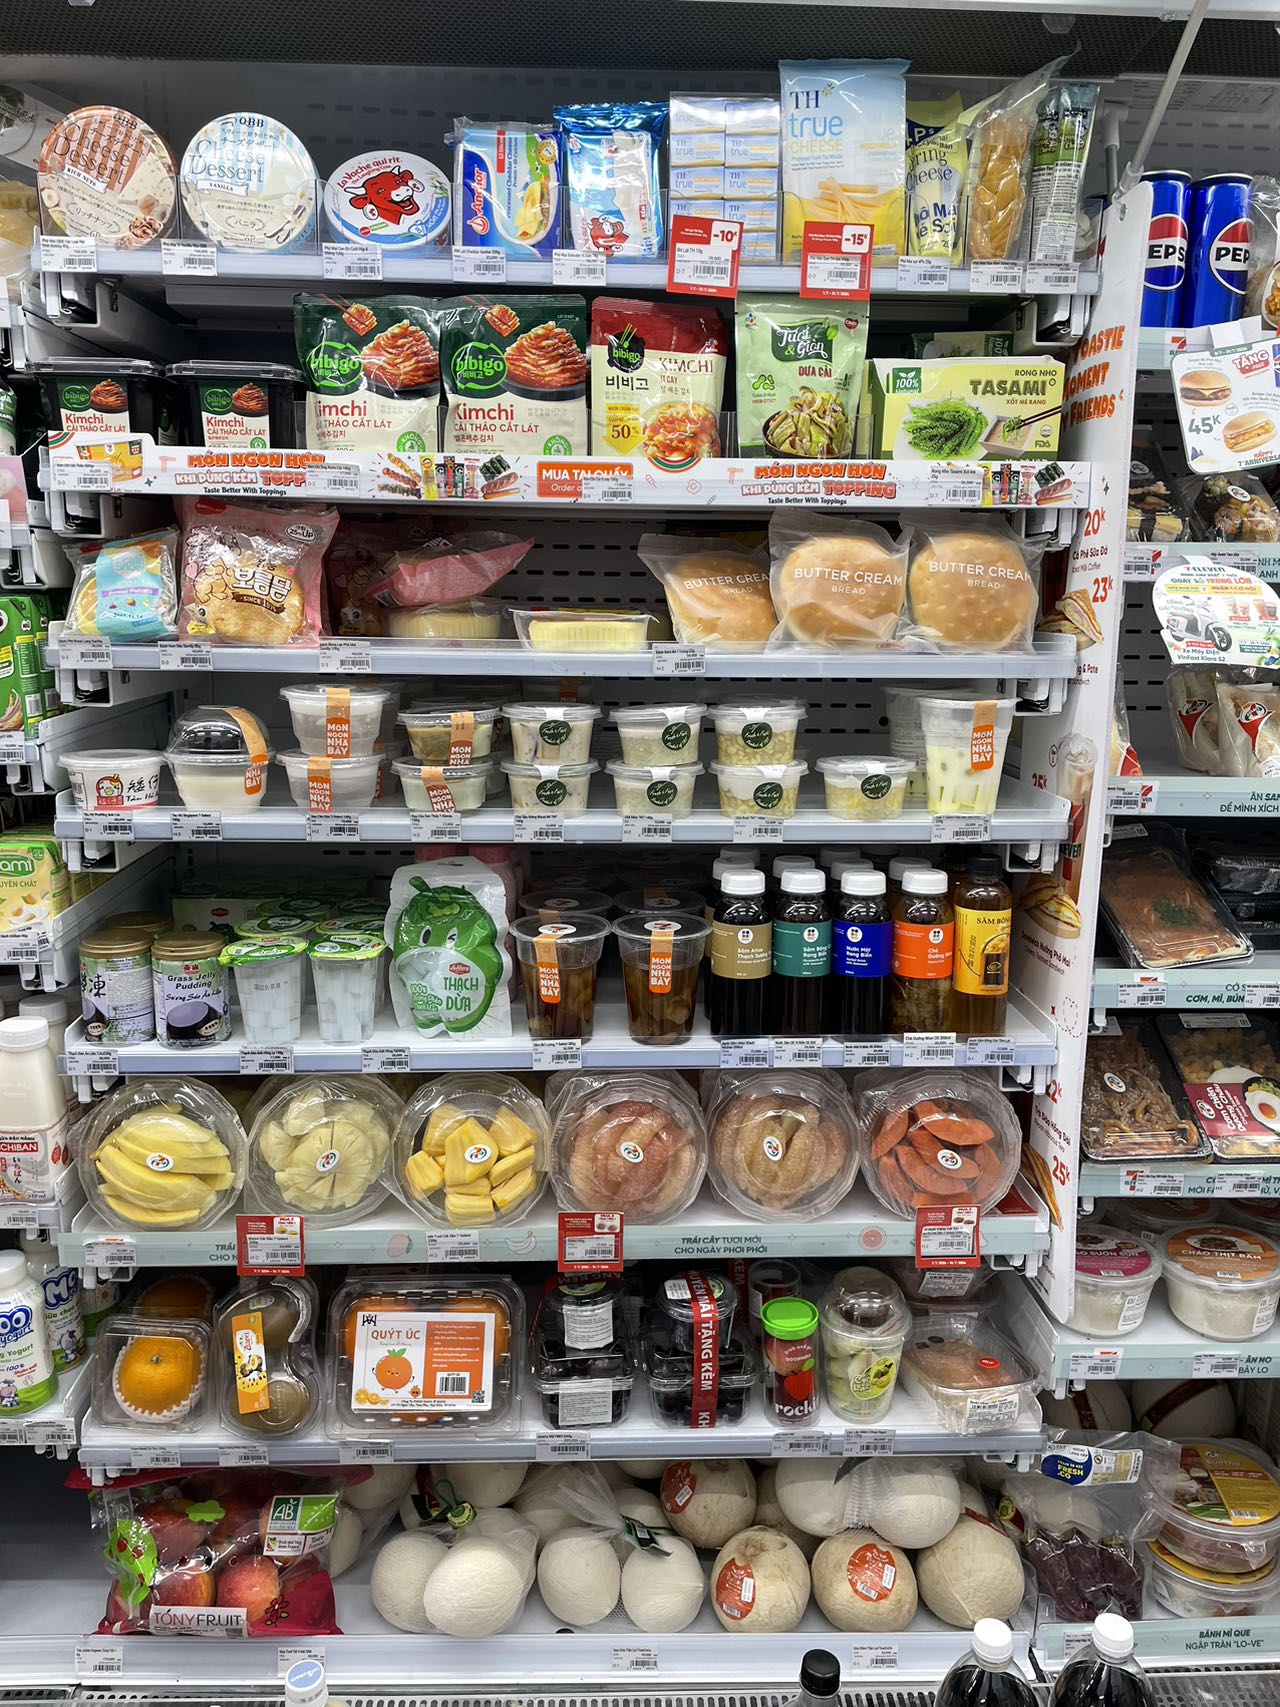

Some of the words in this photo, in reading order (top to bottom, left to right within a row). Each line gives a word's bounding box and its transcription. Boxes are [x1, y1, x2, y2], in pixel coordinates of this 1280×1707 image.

[790, 90, 820, 109] TH
[788, 114, 843, 138] true
[64, 122, 130, 168] Cheese
[195, 139, 266, 165] Cheese
[790, 138, 844, 154] CHEESE
[53, 134, 124, 185] Dessert
[188, 154, 264, 183] Dessert
[343, 163, 373, 181] Vache
[372, 159, 387, 168] qui
[776, 326, 811, 347] Tươi
[784, 344, 795, 356] &
[796, 339, 829, 359] Giòn
[310, 354, 360, 371] bibigo
[456, 356, 504, 375] bibigo
[798, 365, 816, 377] DƯA
[818, 365, 832, 378] CẢI
[606, 375, 649, 391] 비비고
[895, 379, 919, 388] 100%
[969, 379, 1047, 397] TASAMI
[64, 390, 90, 401] bibigo
[1071, 394, 1117, 427] FRIENDS
[65, 414, 104, 425] Kimchi
[207, 416, 244, 428] Kimchi
[1035, 440, 1051, 448] FDA
[188, 453, 229, 468] MÓN
[231, 453, 282, 468] NGON
[754, 462, 795, 478] MÓN
[796, 462, 846, 478] NGON
[848, 462, 886, 479] HƠN
[175, 474, 196, 485] KHI
[199, 472, 231, 485] DÙNG
[233, 472, 257, 484] KÈM
[260, 472, 306, 486] TOPP
[220, 487, 241, 495] Better
[243, 487, 258, 495] With
[259, 488, 287, 497] Toppings
[551, 484, 575, 493] Order
[741, 483, 763, 496] KHI
[764, 481, 795, 495] DÙNG
[796, 482, 820, 494] KÈM
[823, 482, 897, 500] TOPPING
[784, 497, 805, 505] Better
[806, 497, 819, 505] With
[820, 497, 848, 506] Toppings
[929, 561, 984, 577] BUTTER
[684, 575, 734, 591] BUTTER
[736, 572, 770, 586] CREA
[794, 567, 849, 583] BUTTER
[854, 571, 903, 587] CREAM
[967, 579, 1001, 590] BREAD
[233, 567, 293, 604] 보름달
[723, 585, 753, 595] BREAD
[831, 585, 866, 595] BREAD
[1220, 801, 1231, 812] ĐỂ
[1233, 801, 1256, 812] MÌNH
[1258, 801, 1279, 812] XÍCH
[168, 974, 193, 982] Grass
[195, 972, 216, 981] Jelly
[176, 980, 212, 990] Pudding
[443, 977, 479, 994] THẠCH
[446, 992, 471, 1011] DỪA
[1226, 993, 1245, 1003] BÚN
[215, 1242, 236, 1251] TRÁI
[681, 1236, 700, 1245] TRÁI
[701, 1236, 720, 1245] CÂY
[722, 1236, 744, 1244] TƯƠI
[745, 1235, 762, 1244] MỚI
[675, 1246, 692, 1255] CHO
[693, 1245, 721, 1255] NGÀY
[723, 1246, 745, 1254] PHƠI
[747, 1244, 768, 1254] PHỚI
[209, 1253, 231, 1262] CHO
[371, 1326, 402, 1341] QUÝT
[405, 1326, 421, 1340] ÚC
[698, 1320, 716, 1360] TẶNG
[7, 1344, 34, 1358] Yogurt
[1245, 1354, 1257, 1363] ĂN
[1258, 1356, 1272, 1364] NO
[700, 1363, 714, 1391] KÈM
[1257, 1366, 1269, 1374] LO
[1057, 1464, 1084, 1476] FRESH
[273, 1503, 294, 1520] AB
[1199, 1629, 1222, 1639] BÁNH
[1222, 1628, 1234, 1639] MÌ
[1234, 1629, 1251, 1638] QUE
[1185, 1640, 1208, 1652] NGẬP
[1210, 1639, 1232, 1649] TRÀN
